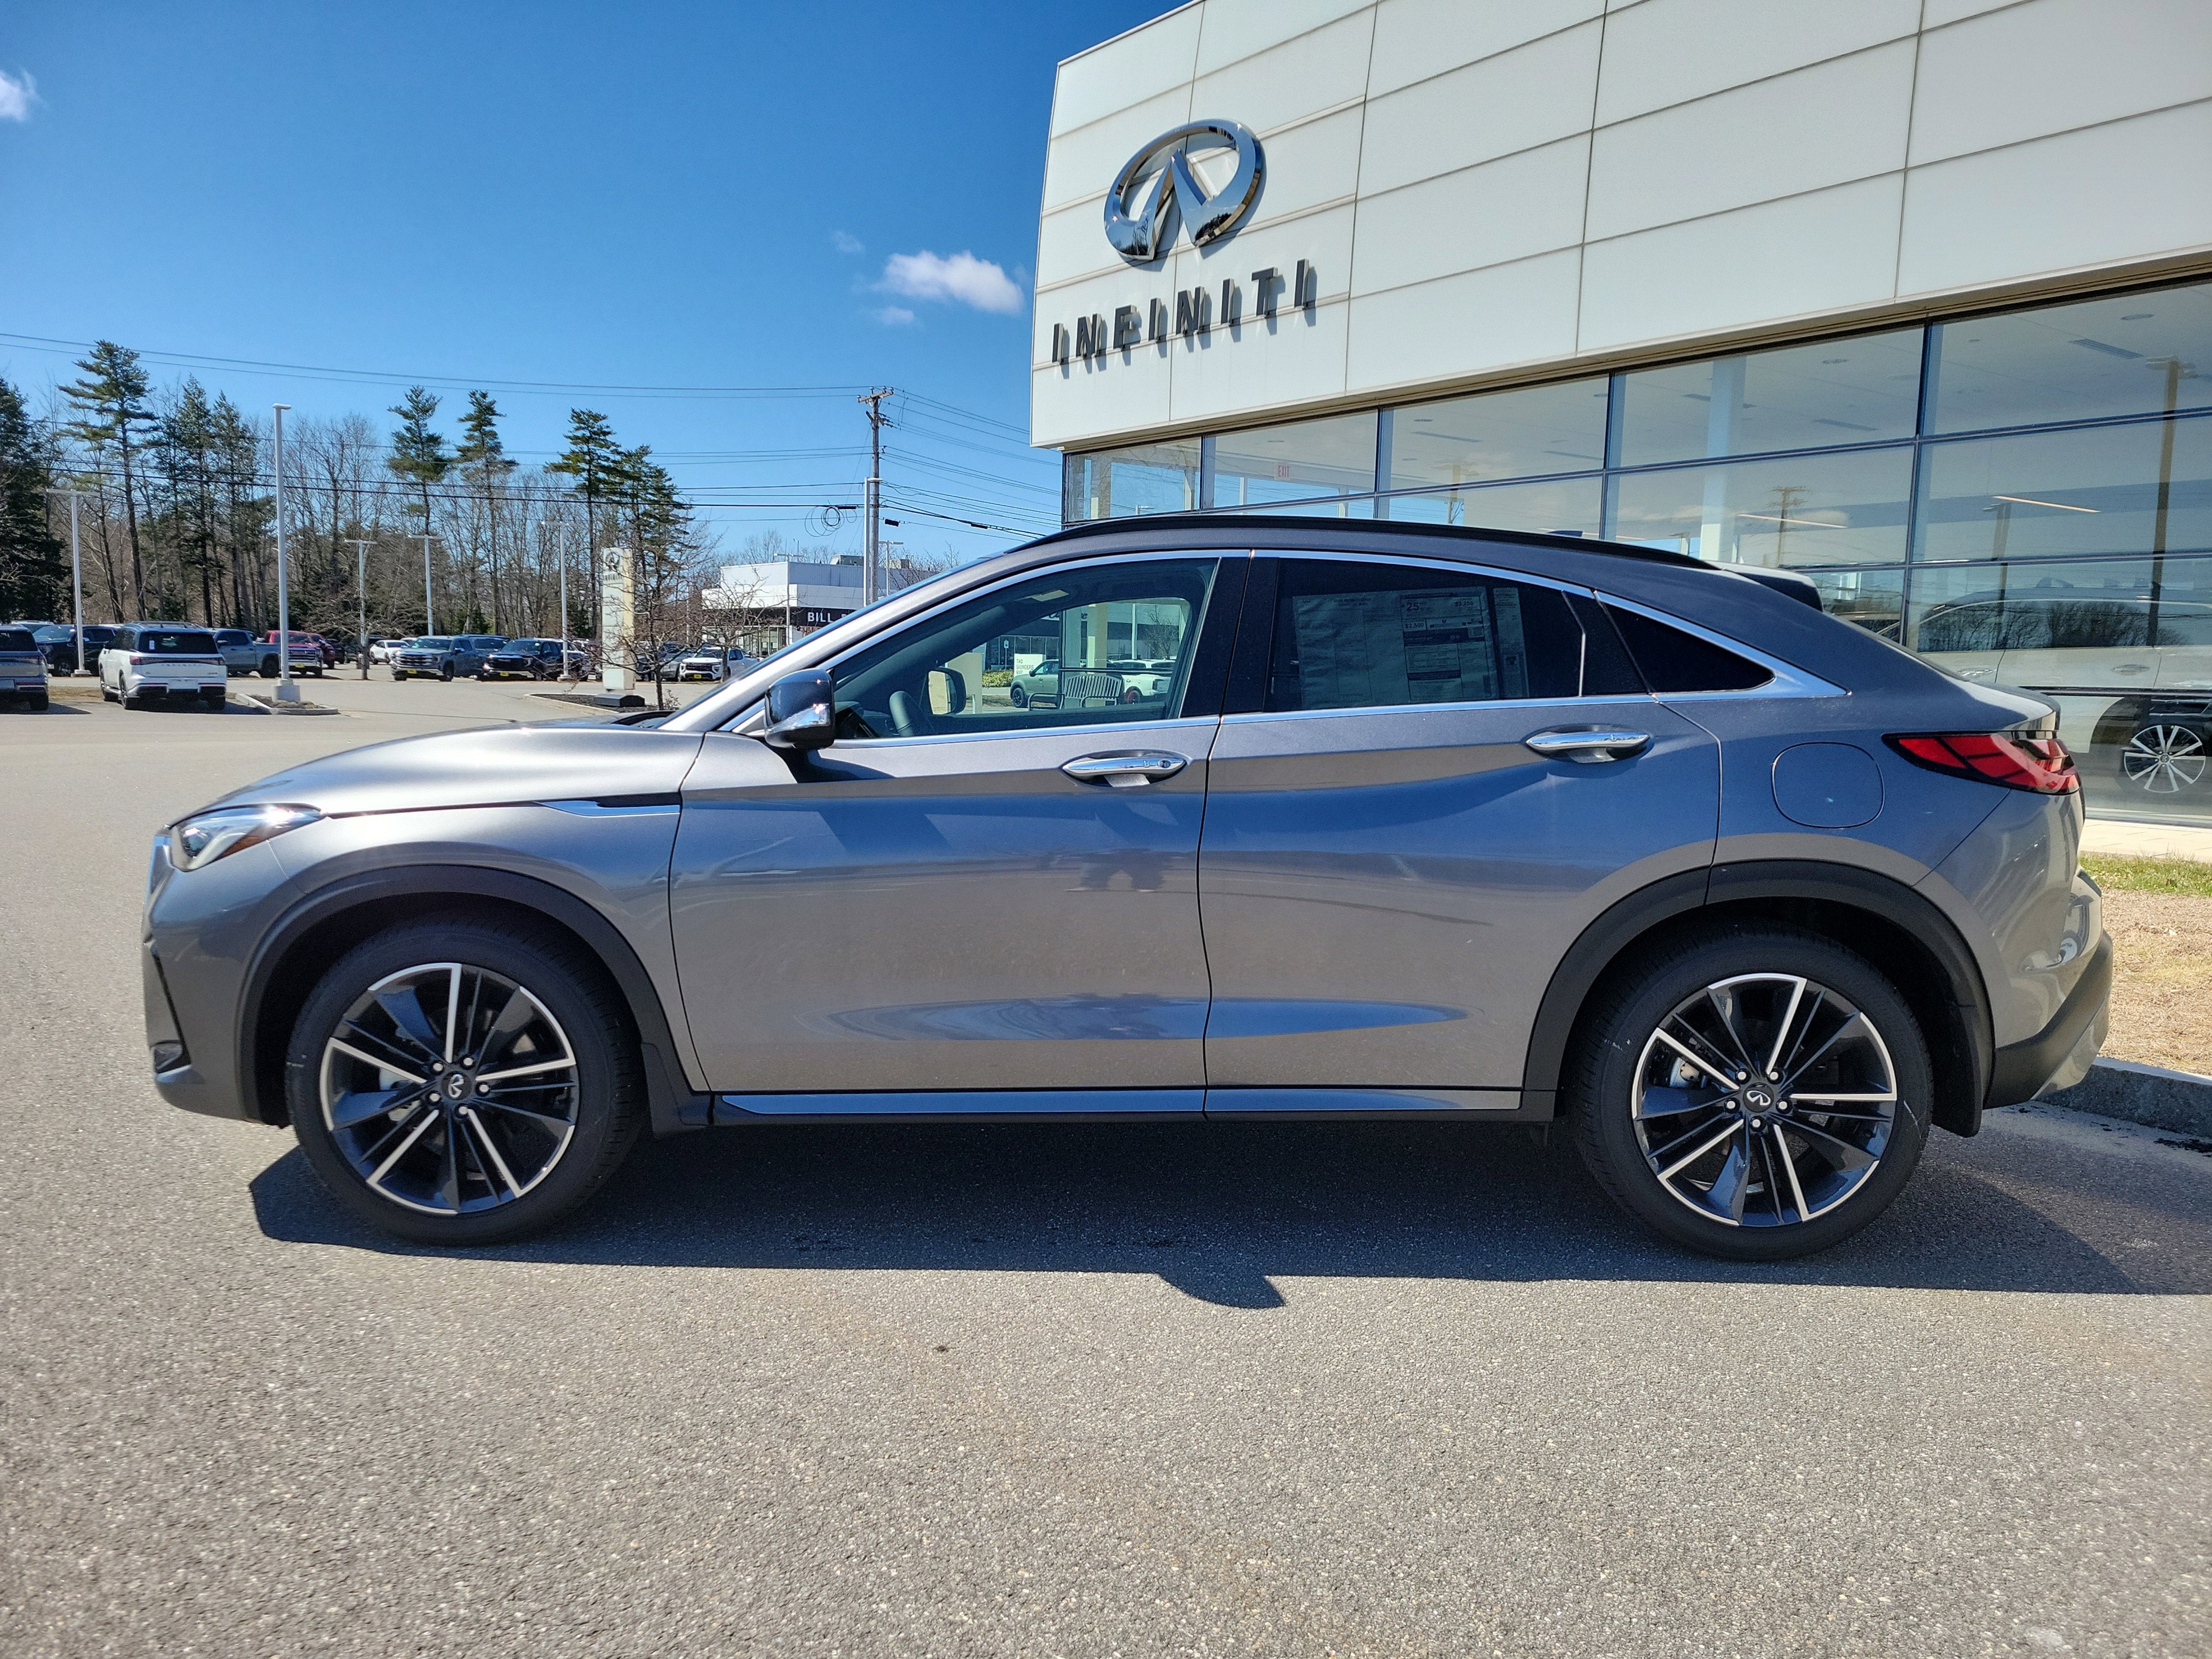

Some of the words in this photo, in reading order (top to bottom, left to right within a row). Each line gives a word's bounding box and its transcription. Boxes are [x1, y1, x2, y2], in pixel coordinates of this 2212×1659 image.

[1052, 258, 1308, 363] INFINITI
[1278, 465, 1290, 477] EXIT
[1406, 602, 1419, 611] 25
[808, 612, 833, 623] BILL
